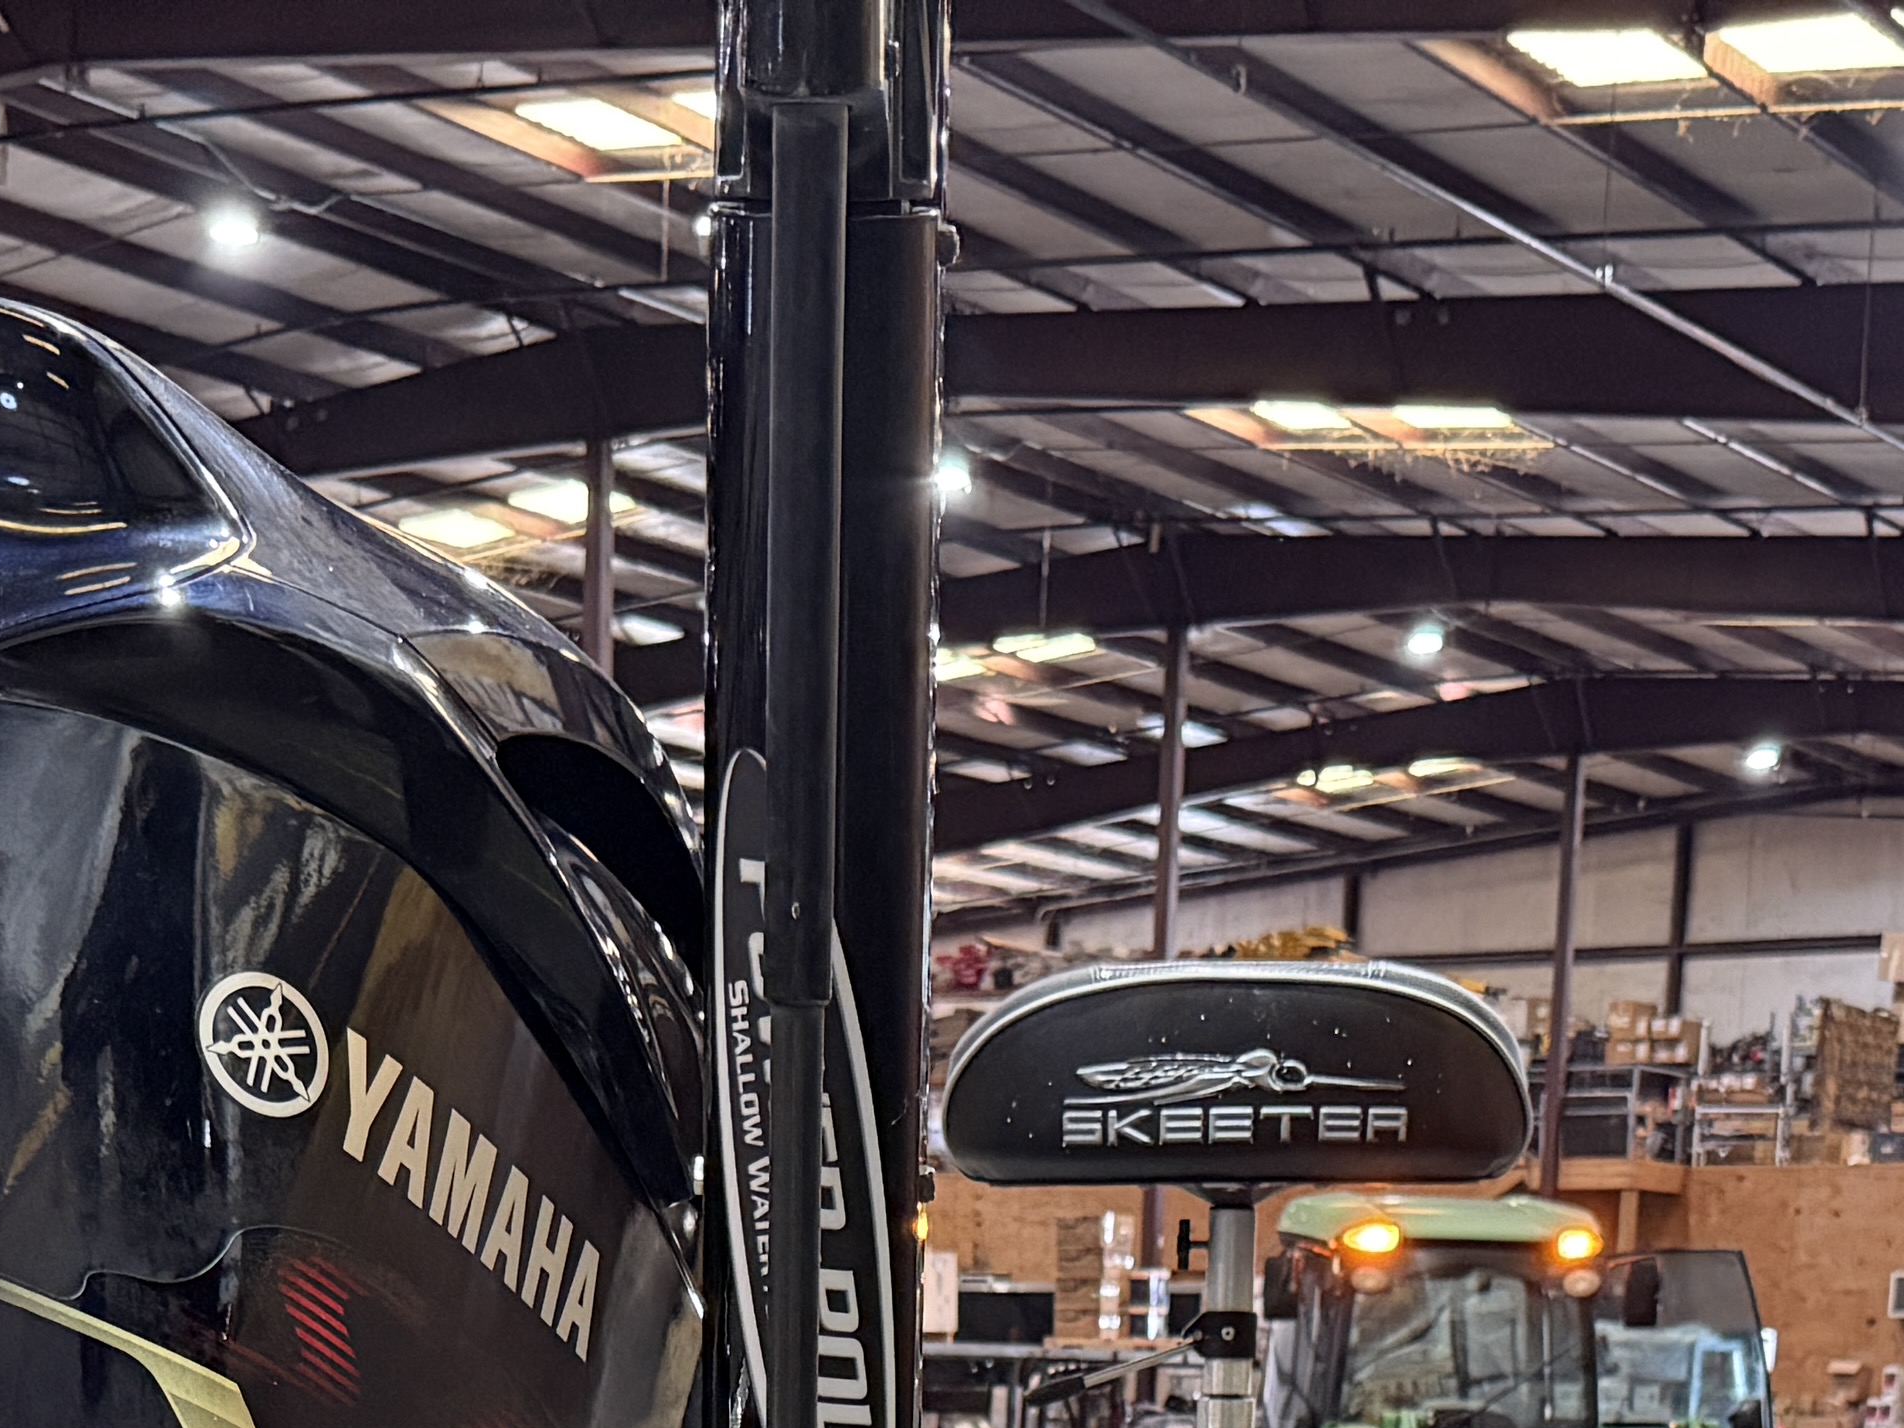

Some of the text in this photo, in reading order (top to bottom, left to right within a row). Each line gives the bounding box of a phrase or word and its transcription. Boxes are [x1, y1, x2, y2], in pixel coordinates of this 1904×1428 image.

[728, 979, 764, 1147] SHALLOW
[1061, 1104, 1410, 1147] SKEETER
[340, 1026, 602, 1364] YAMAHA
